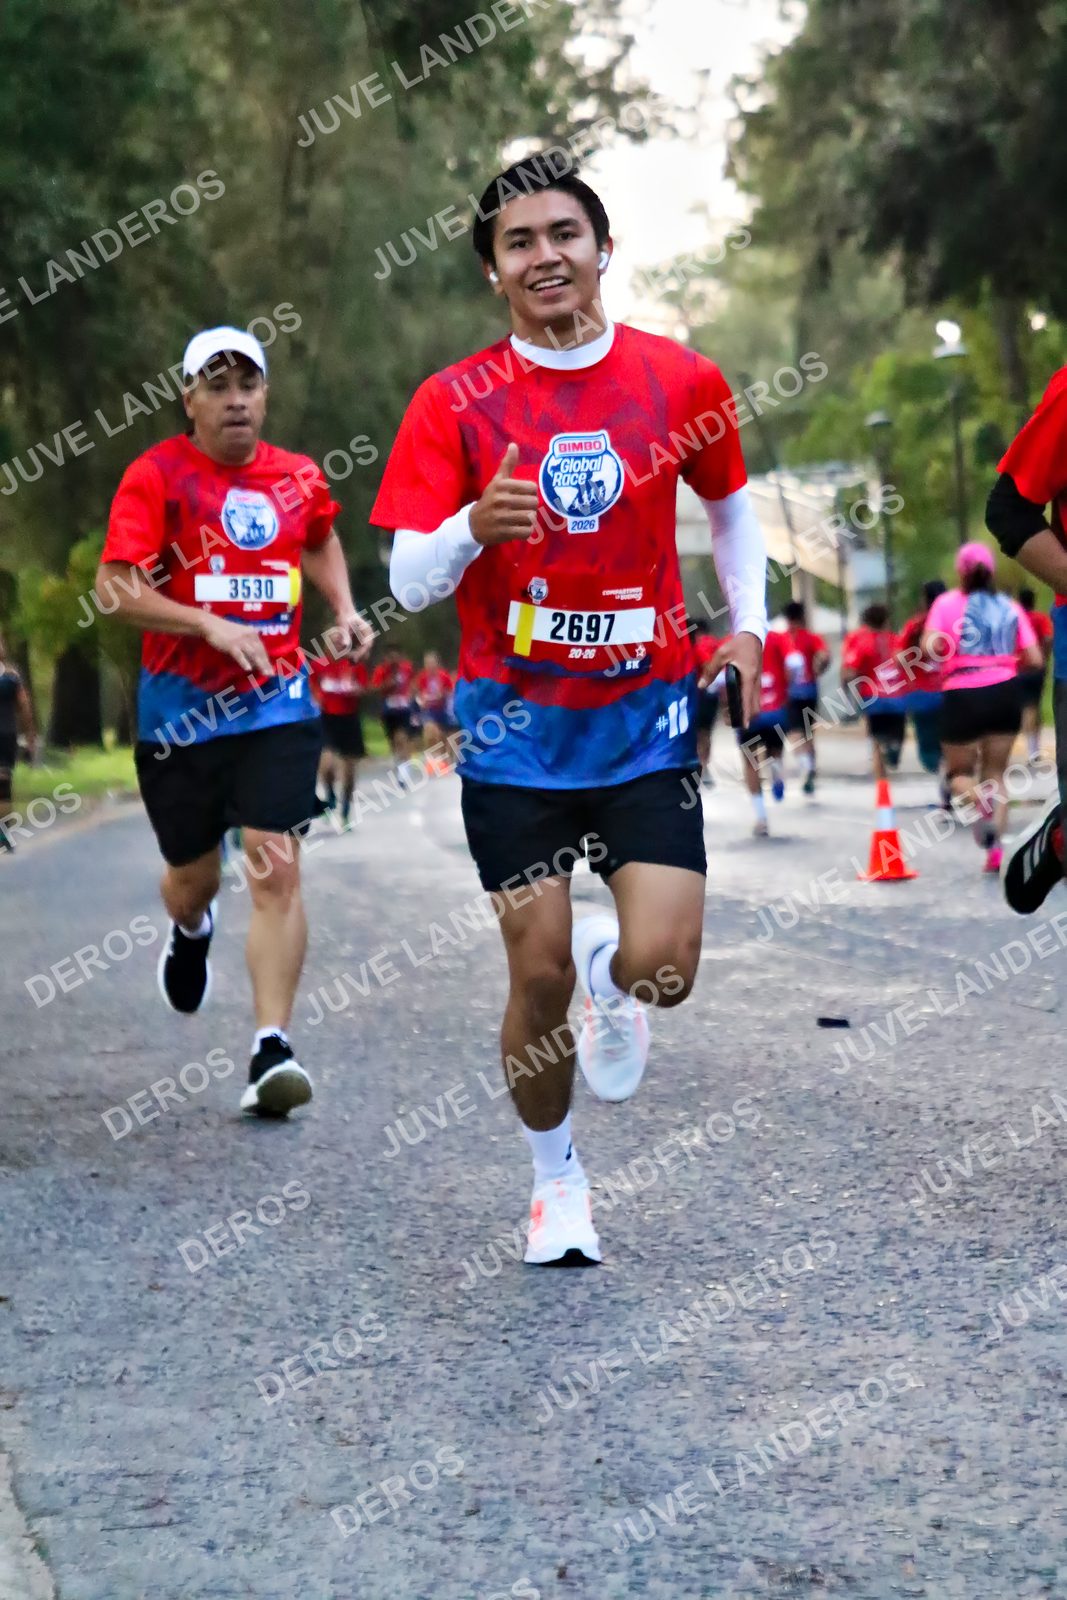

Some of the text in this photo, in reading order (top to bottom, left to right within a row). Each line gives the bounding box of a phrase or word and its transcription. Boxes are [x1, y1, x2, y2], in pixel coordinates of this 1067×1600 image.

[558, 440, 602, 453] BIMBO
[560, 456, 602, 473] Global
[552, 471, 587, 487] Race
[571, 519, 596, 531] 2026
[229, 578, 274, 600] 3530
[550, 612, 616, 643] 2697
